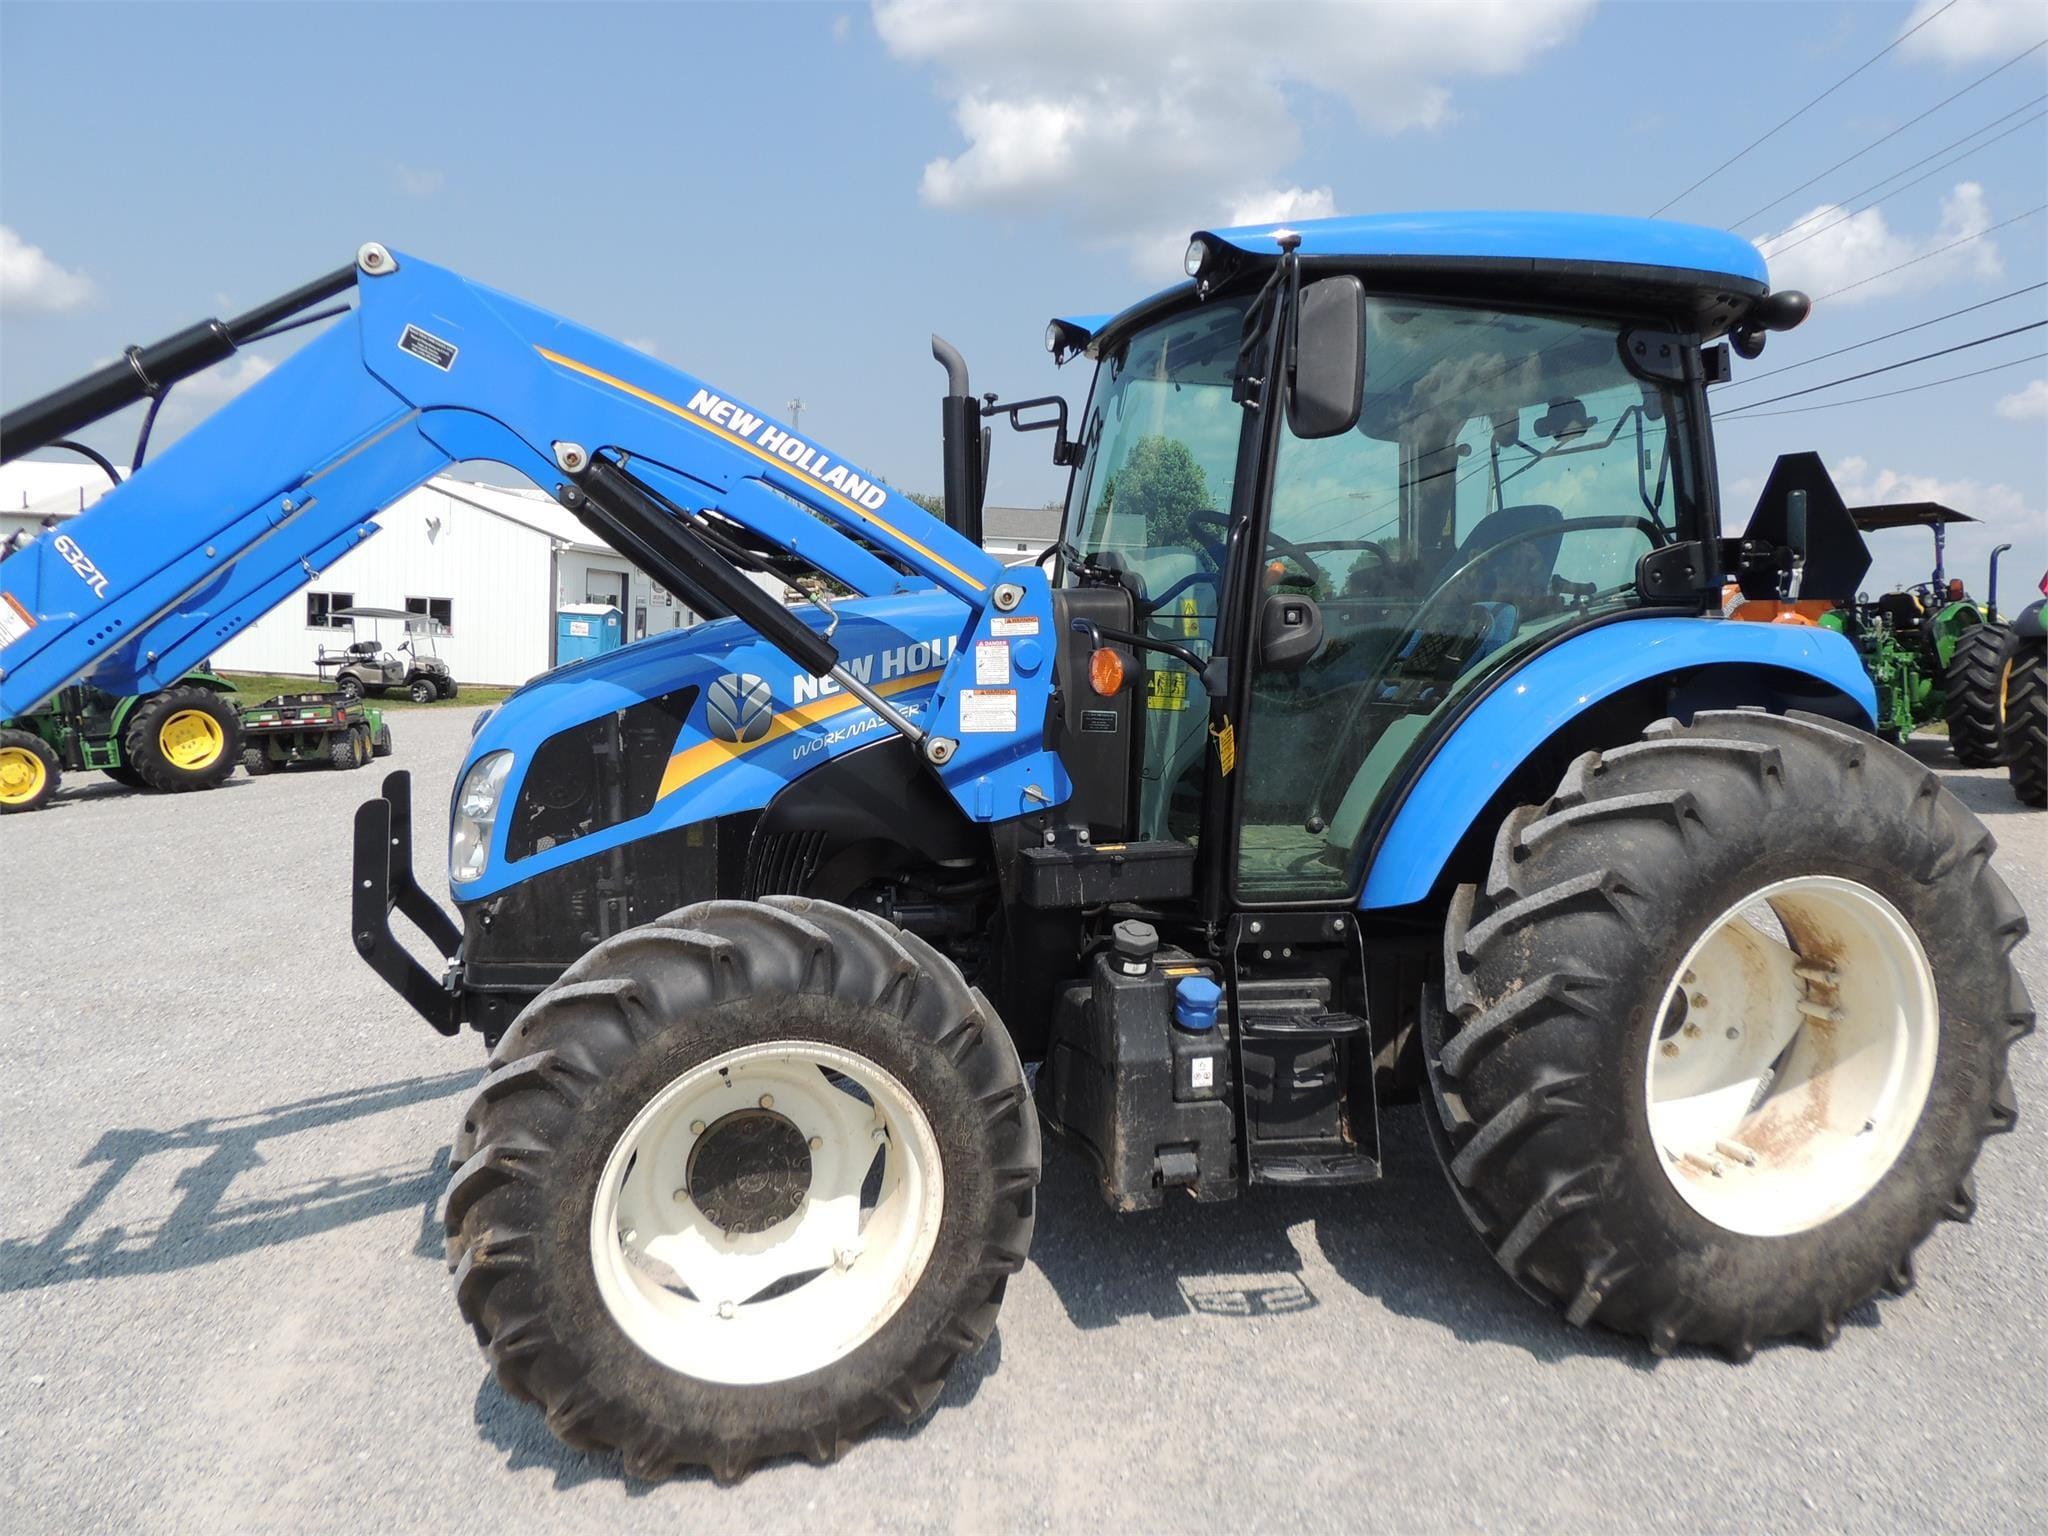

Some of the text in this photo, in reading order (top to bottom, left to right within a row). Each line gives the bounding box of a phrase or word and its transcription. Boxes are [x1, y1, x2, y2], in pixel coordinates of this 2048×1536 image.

[686, 388, 888, 511] NEW HOLLAND
[53, 534, 110, 600] 632TL
[792, 703, 920, 761] WORKMASER
